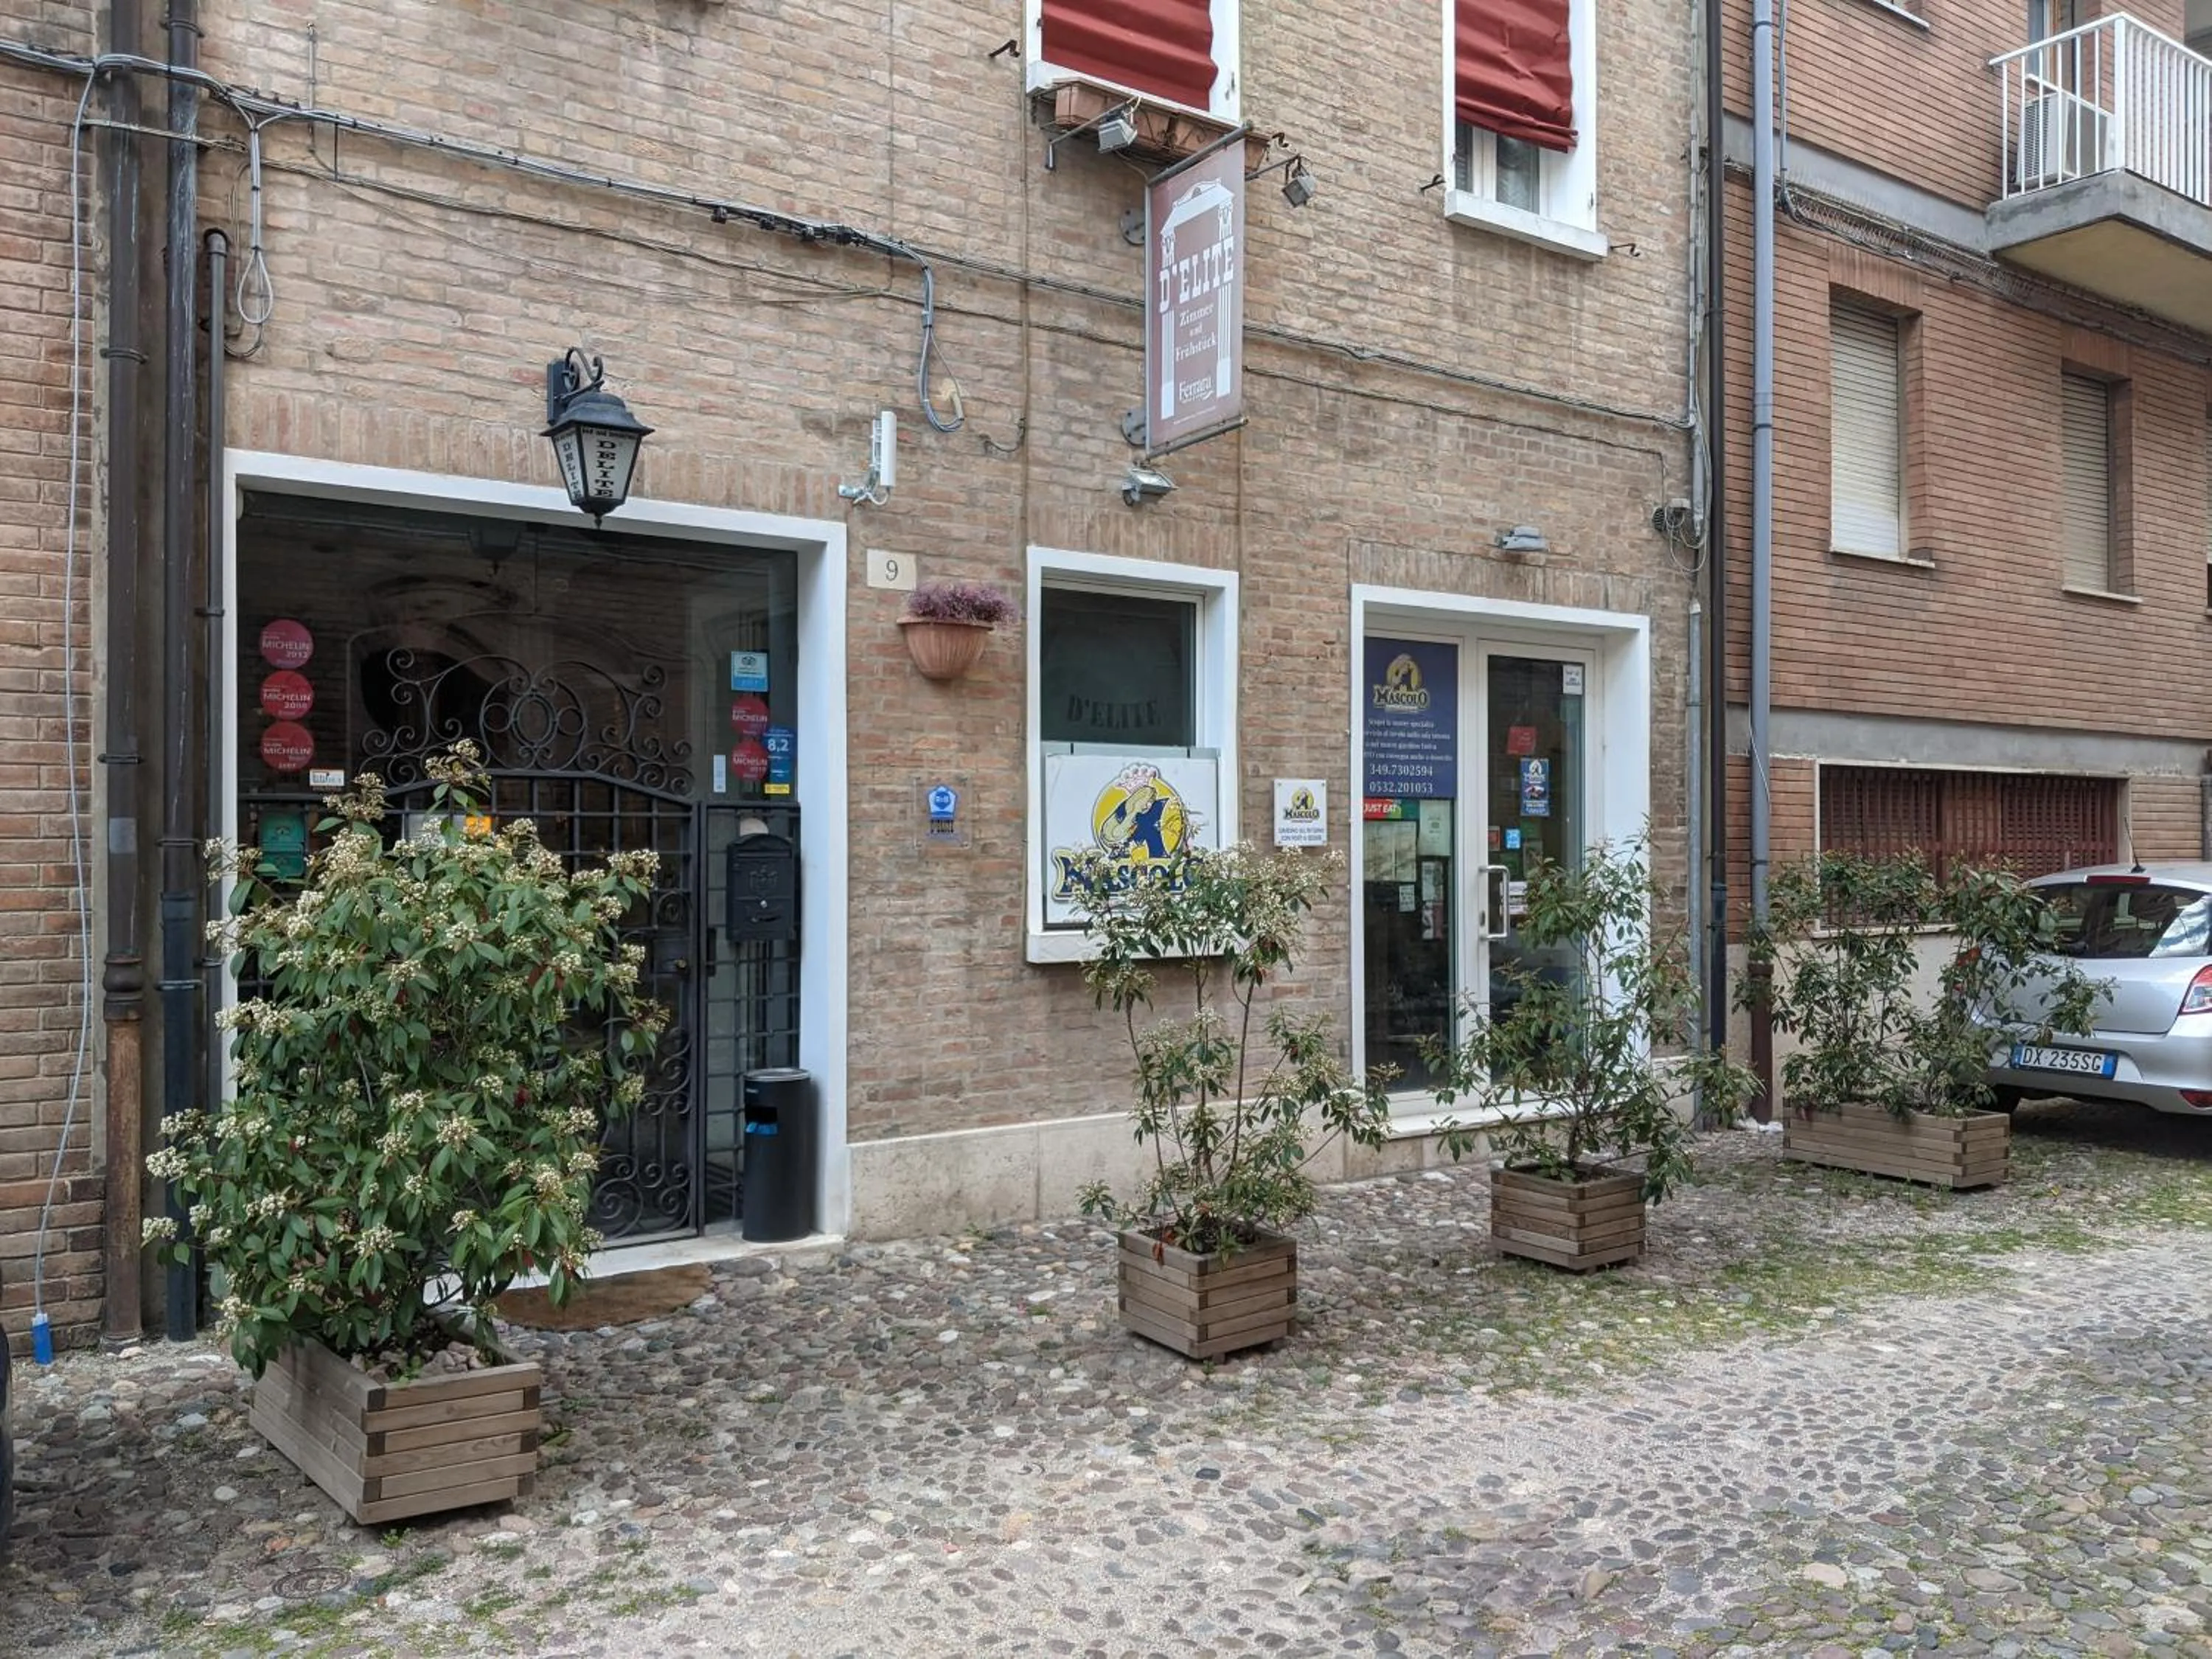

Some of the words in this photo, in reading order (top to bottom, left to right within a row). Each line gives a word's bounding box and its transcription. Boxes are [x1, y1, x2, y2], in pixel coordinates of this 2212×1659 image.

[1160, 236, 1234, 313] D'ELITE
[886, 560, 899, 582] 9
[262, 639, 310, 650] MICHELIN
[263, 692, 310, 701] MICHELIN
[1374, 687, 1427, 705] MASCOLO
[264, 746, 310, 755] MICHELIN
[768, 738, 789, 752] 8,2
[2023, 1048, 2045, 1065] DX
[2049, 1051, 2102, 1071] 235SG
